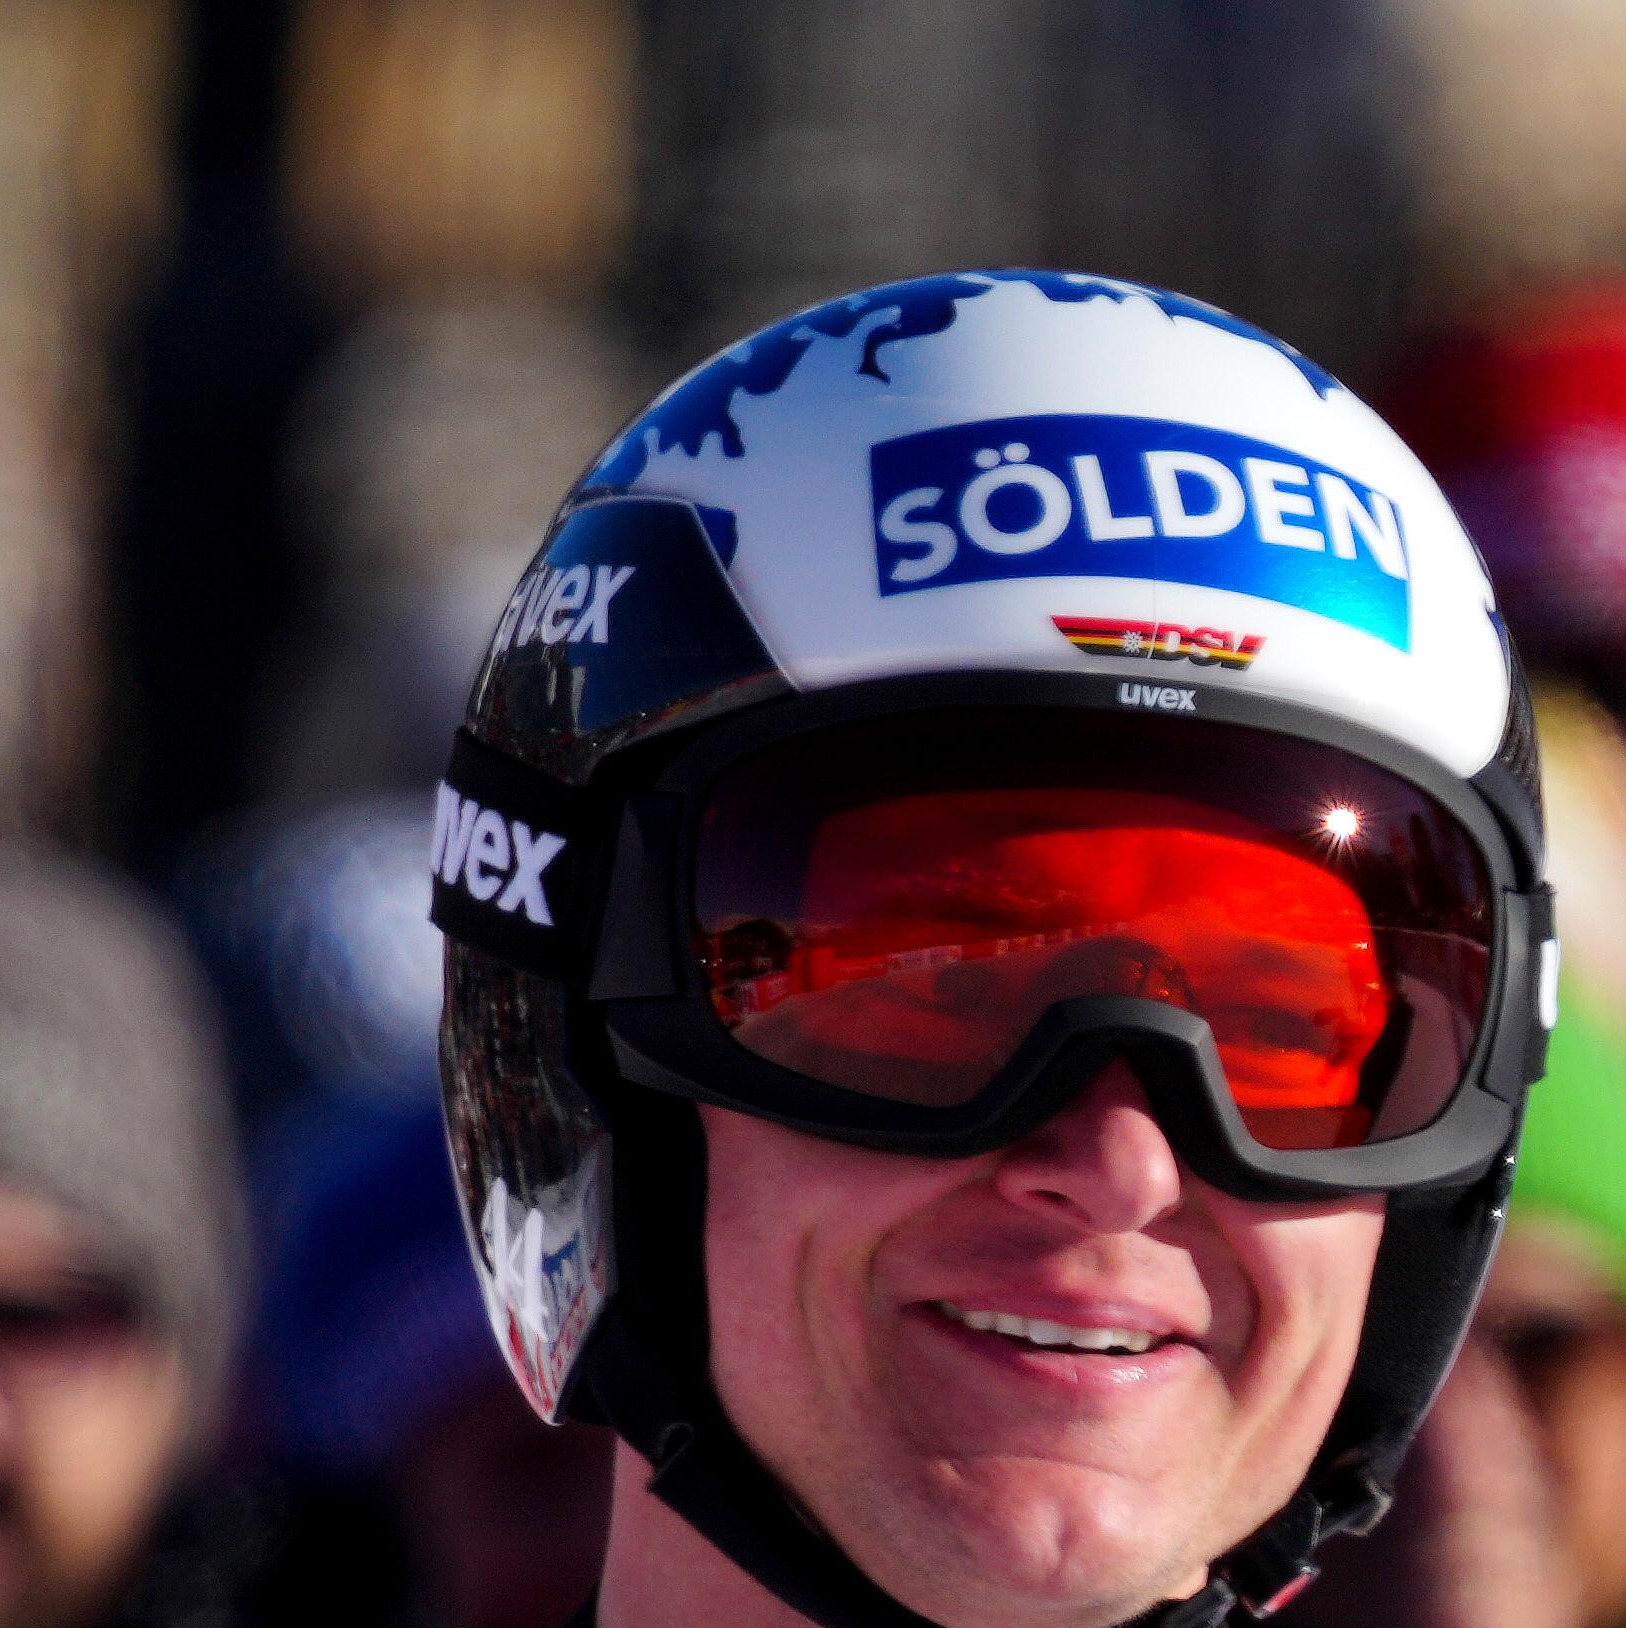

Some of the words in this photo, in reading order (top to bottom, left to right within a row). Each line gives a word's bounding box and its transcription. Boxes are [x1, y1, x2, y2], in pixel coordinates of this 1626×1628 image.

[879, 442, 1409, 582] SÖLDEN
[1151, 623, 1267, 670] DSV
[1118, 682, 1197, 711] uvex
